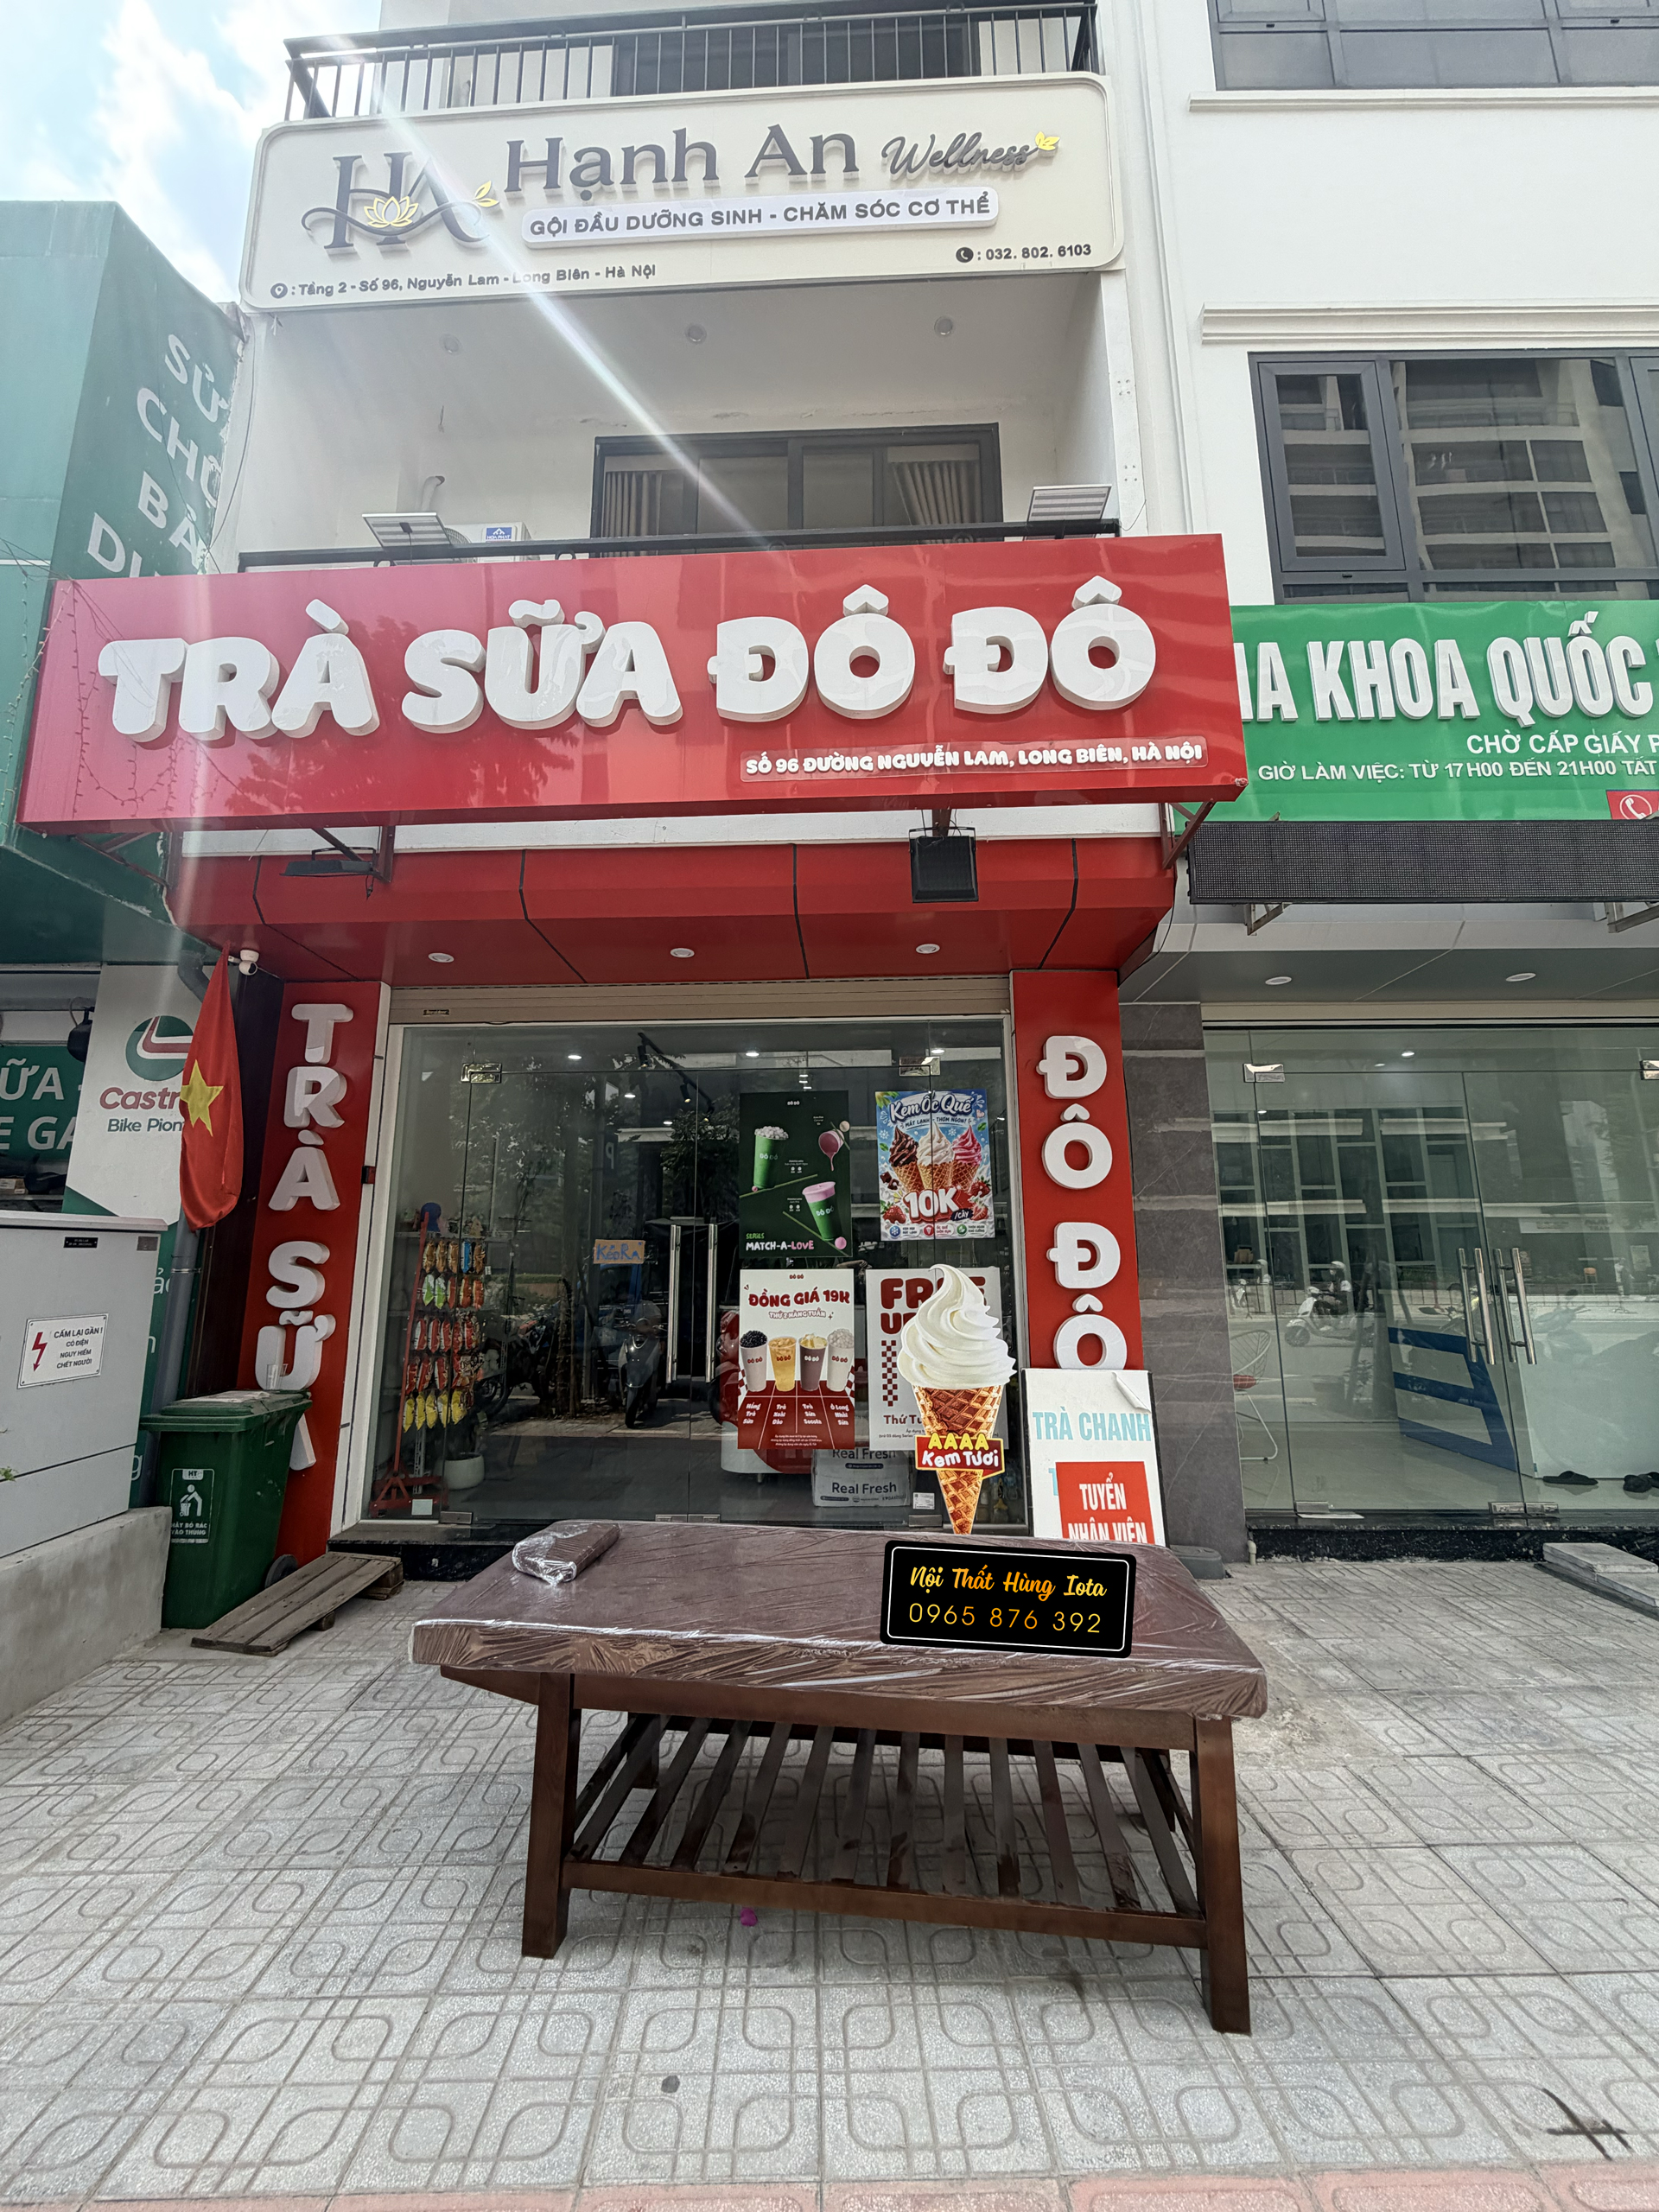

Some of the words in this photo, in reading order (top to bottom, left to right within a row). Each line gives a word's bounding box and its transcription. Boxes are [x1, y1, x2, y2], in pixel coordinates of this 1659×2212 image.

[504, 127, 720, 201] Hạnh
[745, 124, 860, 178] An
[880, 130, 1039, 176] Wellness
[530, 215, 568, 237] GỘI
[574, 211, 619, 233] ĐẦU
[626, 208, 703, 231] DƯỠNG
[710, 208, 762, 226] SINH
[783, 201, 847, 222] CHĂM
[855, 199, 900, 219] SÓC
[908, 199, 941, 216] CƠ
[945, 191, 990, 215] THỂ
[1057, 243, 1091, 257] 6103
[298, 281, 334, 296] Tầng
[337, 282, 347, 294] 2
[359, 277, 380, 292] Số
[381, 278, 404, 291] 96,
[407, 273, 463, 291] Nguyễn
[467, 274, 499, 286] Lam
[512, 271, 550, 285] Long
[556, 268, 590, 282] Biên
[605, 265, 626, 278] Hà
[631, 264, 657, 280] Nội
[98, 598, 380, 742] TRÀ
[402, 598, 683, 734] SỮA
[707, 583, 916, 722] ĐÔ
[944, 575, 1157, 715] ĐÔ
[1306, 637, 1481, 721] KHOA
[1486, 610, 1654, 728] QUỐC
[1466, 728, 1522, 754] CHỜ
[1529, 729, 1579, 753] CẤP
[1583, 730, 1642, 754] GIẤY
[746, 751, 772, 774] SỐ
[775, 758, 799, 772] 96
[803, 751, 874, 772] ĐƯỜNG
[877, 744, 960, 770] NGUYỄN
[963, 750, 1015, 767] LAM,
[1018, 748, 1073, 766] LONG
[1075, 743, 1129, 765] BIÊN,
[1131, 741, 1162, 760] HÀ
[1164, 741, 1203, 765] NỘI
[1257, 760, 1296, 780] GIỜ
[1300, 761, 1347, 780] LÀM
[1351, 762, 1405, 783] VIỆC:
[1408, 760, 1440, 779] TỪ
[1509, 757, 1552, 777] ĐẾN
[1556, 760, 1617, 776] 21H00
[1621, 755, 1657, 776] TẤT
[99, 1086, 181, 1110] Castr
[268, 1003, 354, 1211] TRÀ
[890, 1101, 921, 1122] Kem
[921, 1090, 938, 1113] Ốc
[940, 1093, 975, 1115] Quế
[1036, 1034, 1113, 1190] ĐÔ
[107, 1118, 142, 1132] Bike
[147, 1119, 184, 1132] Pion
[904, 1187, 959, 1218] 10K
[748, 1288, 791, 1307] ĐỒNG
[793, 1286, 820, 1306] GIÁ
[823, 1289, 850, 1304] 19K
[1046, 1221, 1128, 1370] ĐÔ
[54, 1328, 72, 1338] CẤM
[883, 1414, 908, 1425] Thứ
[1032, 1406, 1074, 1440] TRÀ
[1078, 1412, 1152, 1441] CHANH
[832, 1447, 859, 1459] Real
[922, 1450, 961, 1468] Kem
[963, 1449, 1000, 1467] Tươi
[832, 1482, 859, 1494] Real
[862, 1481, 897, 1494] Fresh
[1078, 1471, 1128, 1510] TUYỂN
[1067, 1516, 1110, 1541] NHÂN
[1111, 1516, 1148, 1544] VIÊN
